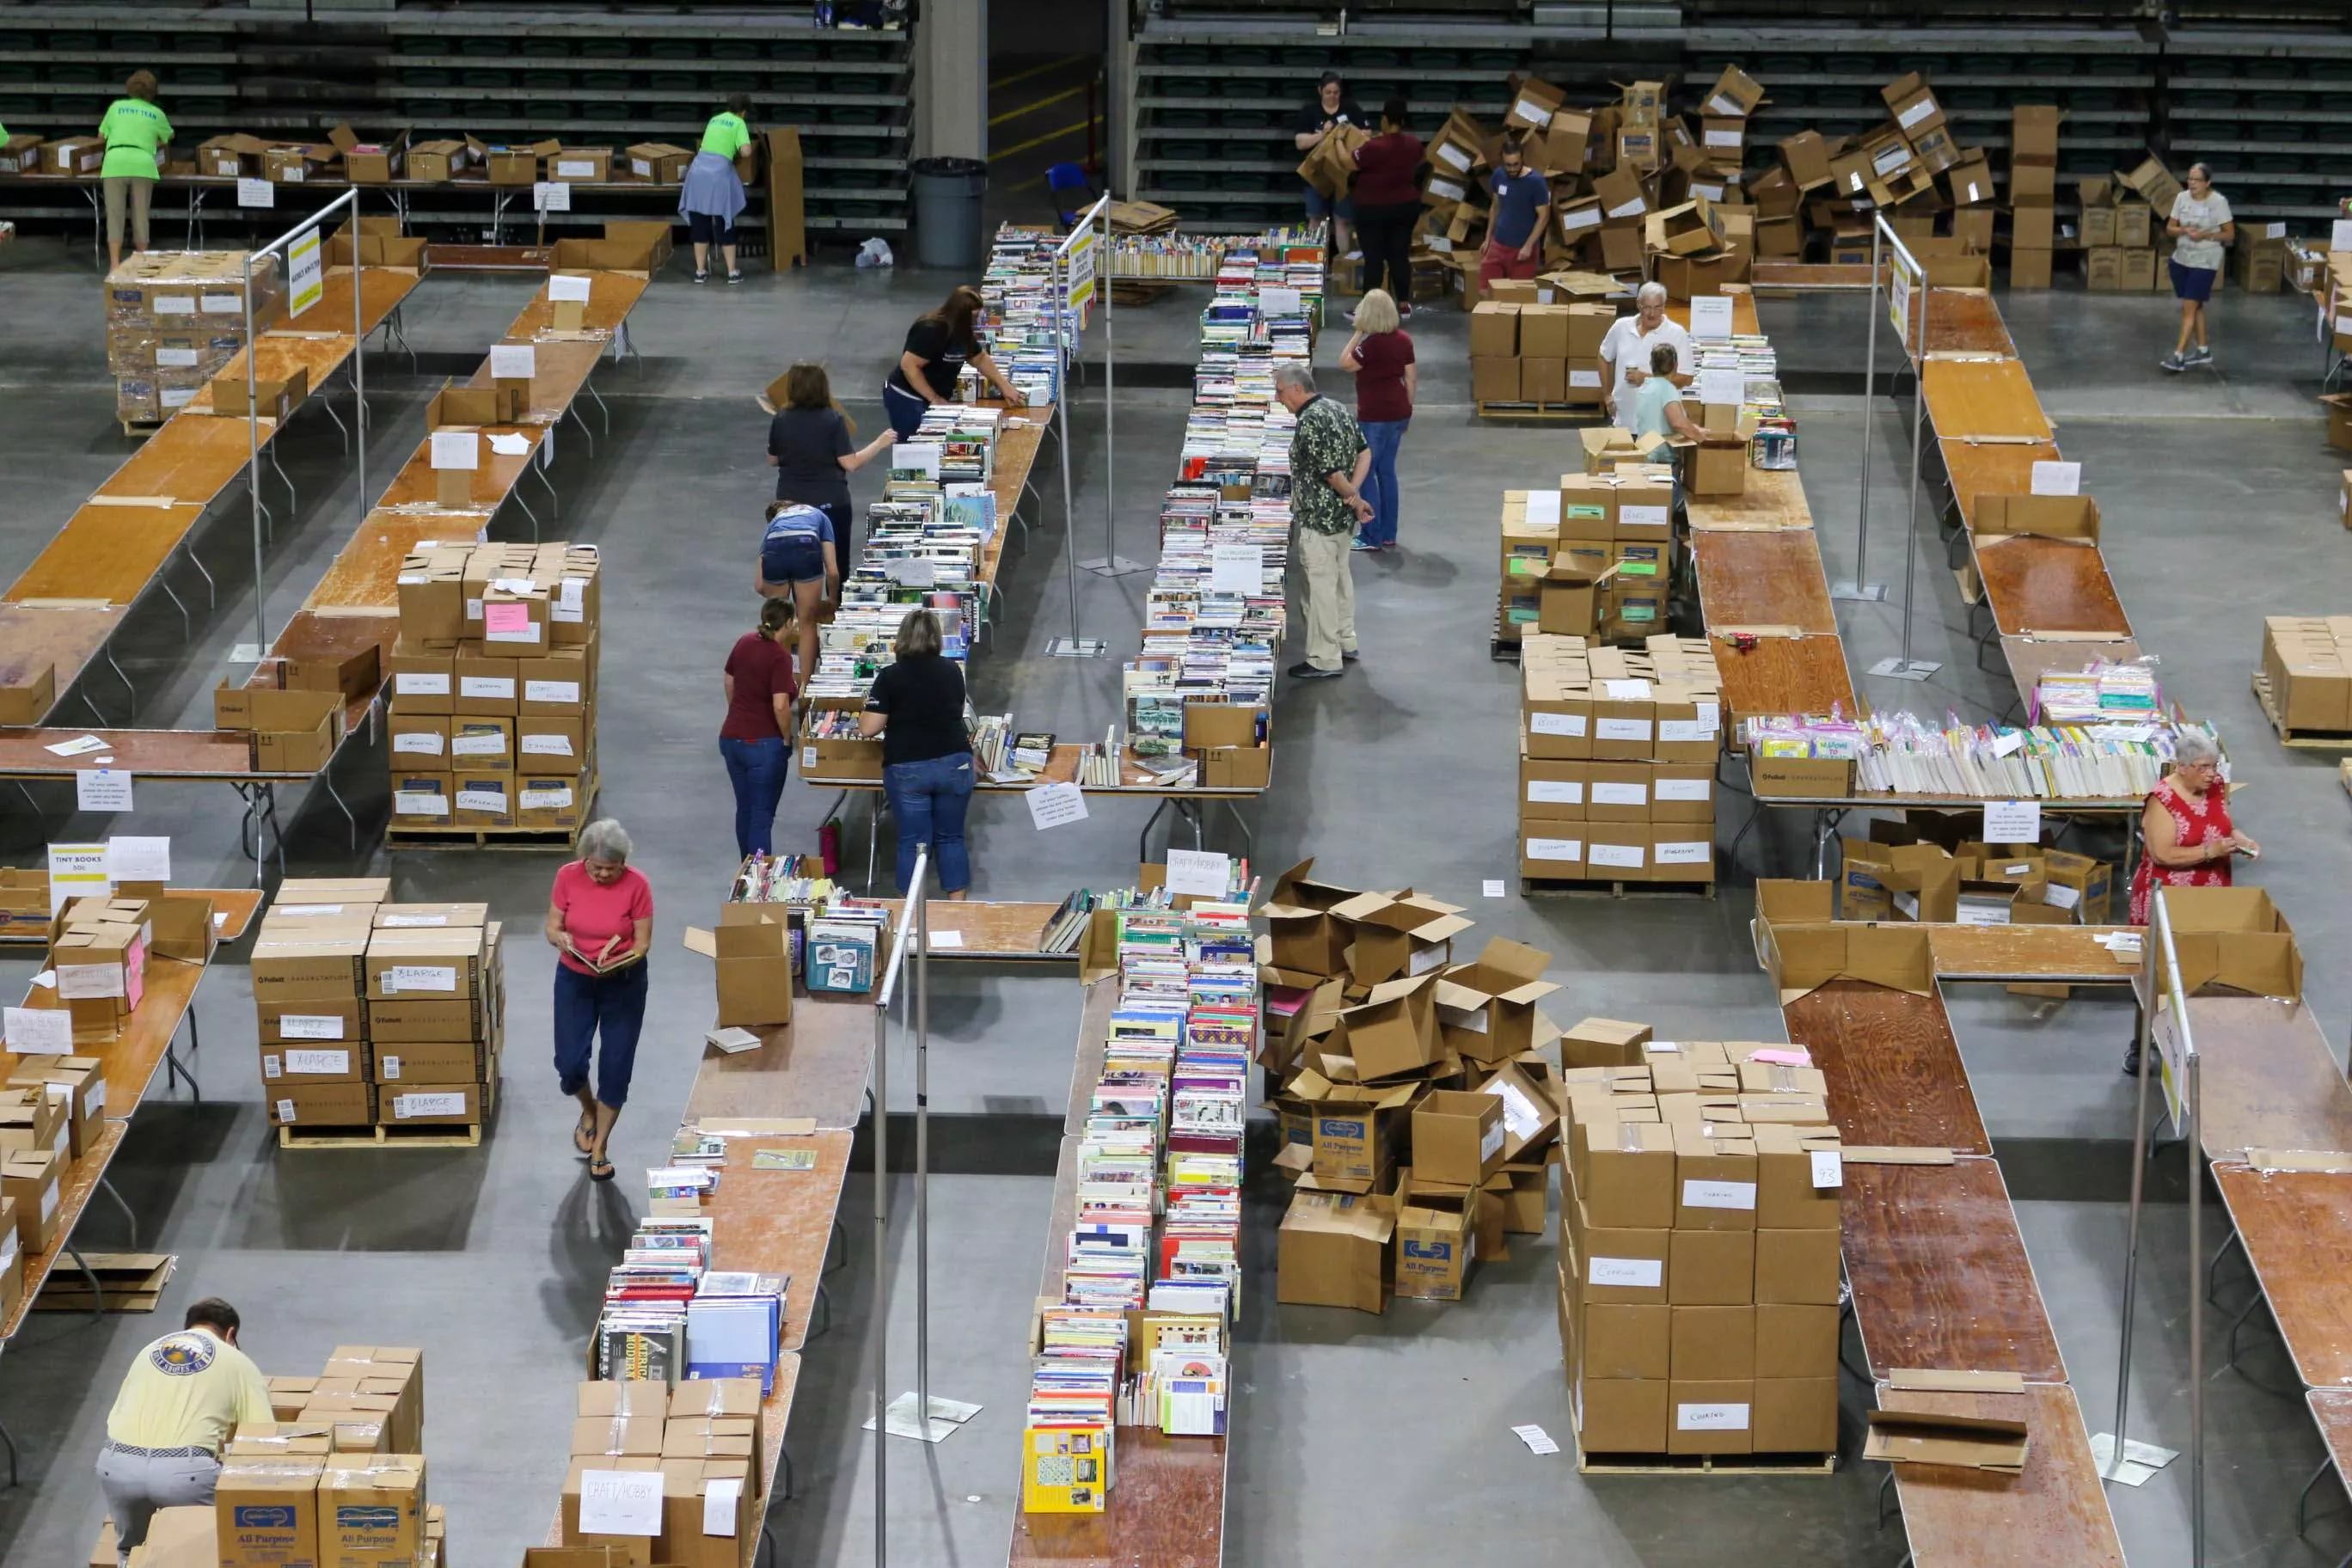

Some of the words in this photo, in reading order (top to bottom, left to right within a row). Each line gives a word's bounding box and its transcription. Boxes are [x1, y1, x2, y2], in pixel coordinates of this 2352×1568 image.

[141, 110, 156, 120] TEAM
[459, 795, 503, 809] GARDENING
[1334, 1142, 1363, 1152] Purpose
[1819, 1168, 1835, 1184] 93
[1418, 1263, 1449, 1273] Purpose
[626, 1334, 635, 1378] MODERN
[587, 1481, 653, 1503] CRAFT/HOBBY
[237, 1534, 253, 1543] All
[255, 1534, 296, 1545] Purpose
[341, 1535, 354, 1544] All
[357, 1534, 396, 1546] Purpose
